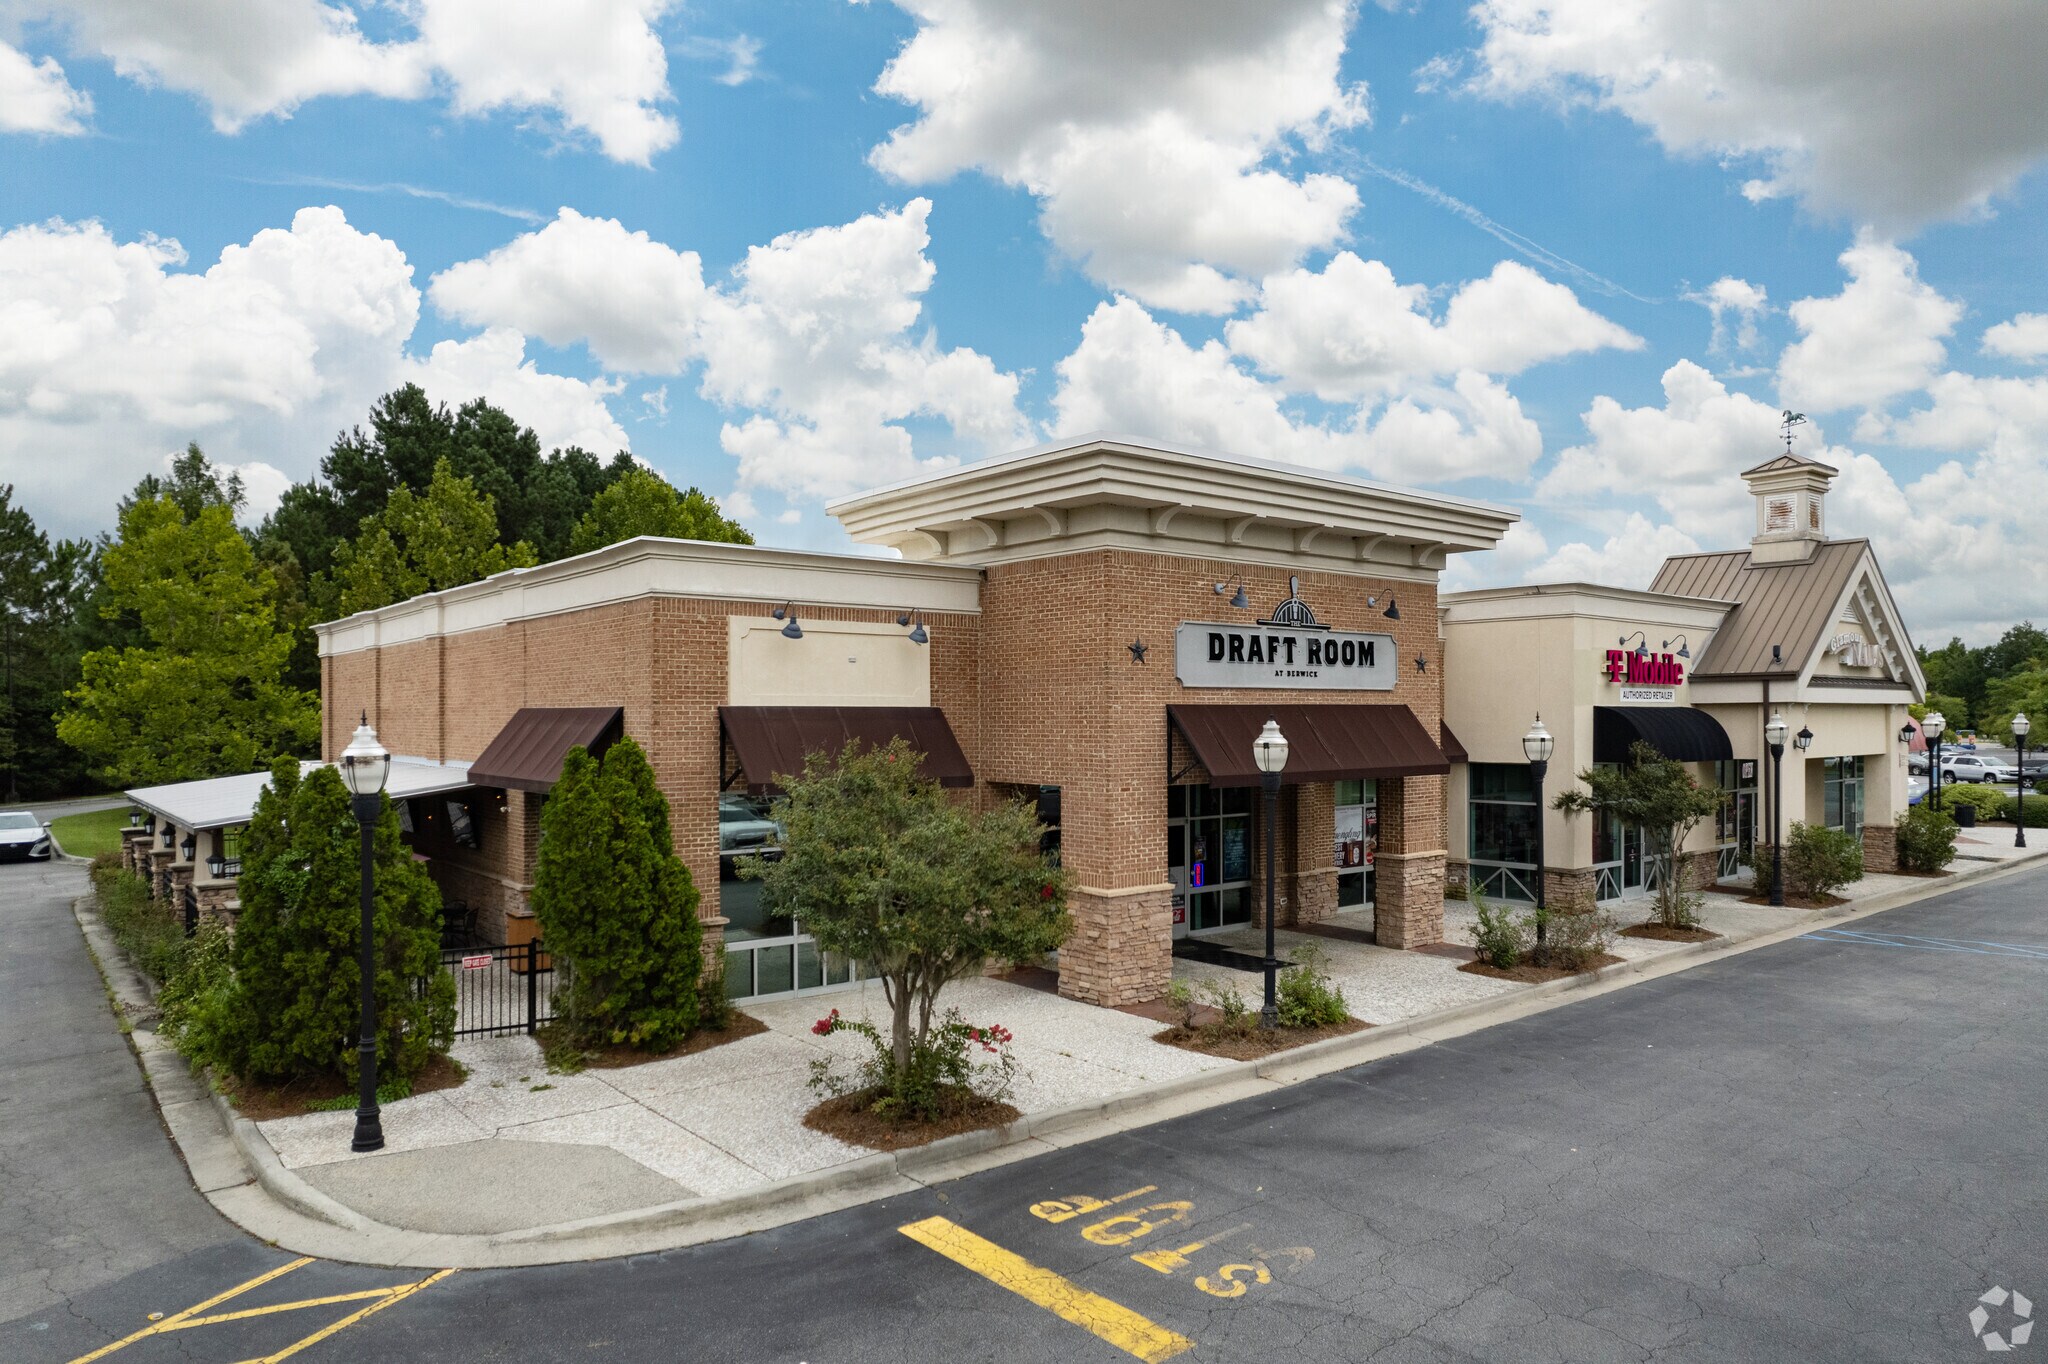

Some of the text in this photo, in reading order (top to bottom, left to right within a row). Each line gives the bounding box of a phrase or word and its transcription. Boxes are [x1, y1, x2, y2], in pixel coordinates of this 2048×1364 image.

[1208, 632, 1375, 668] DRAFT ROOM
[1287, 670, 1318, 678] BERWICK
[1622, 690, 1673, 700] AUTHORIZED RETAILER
